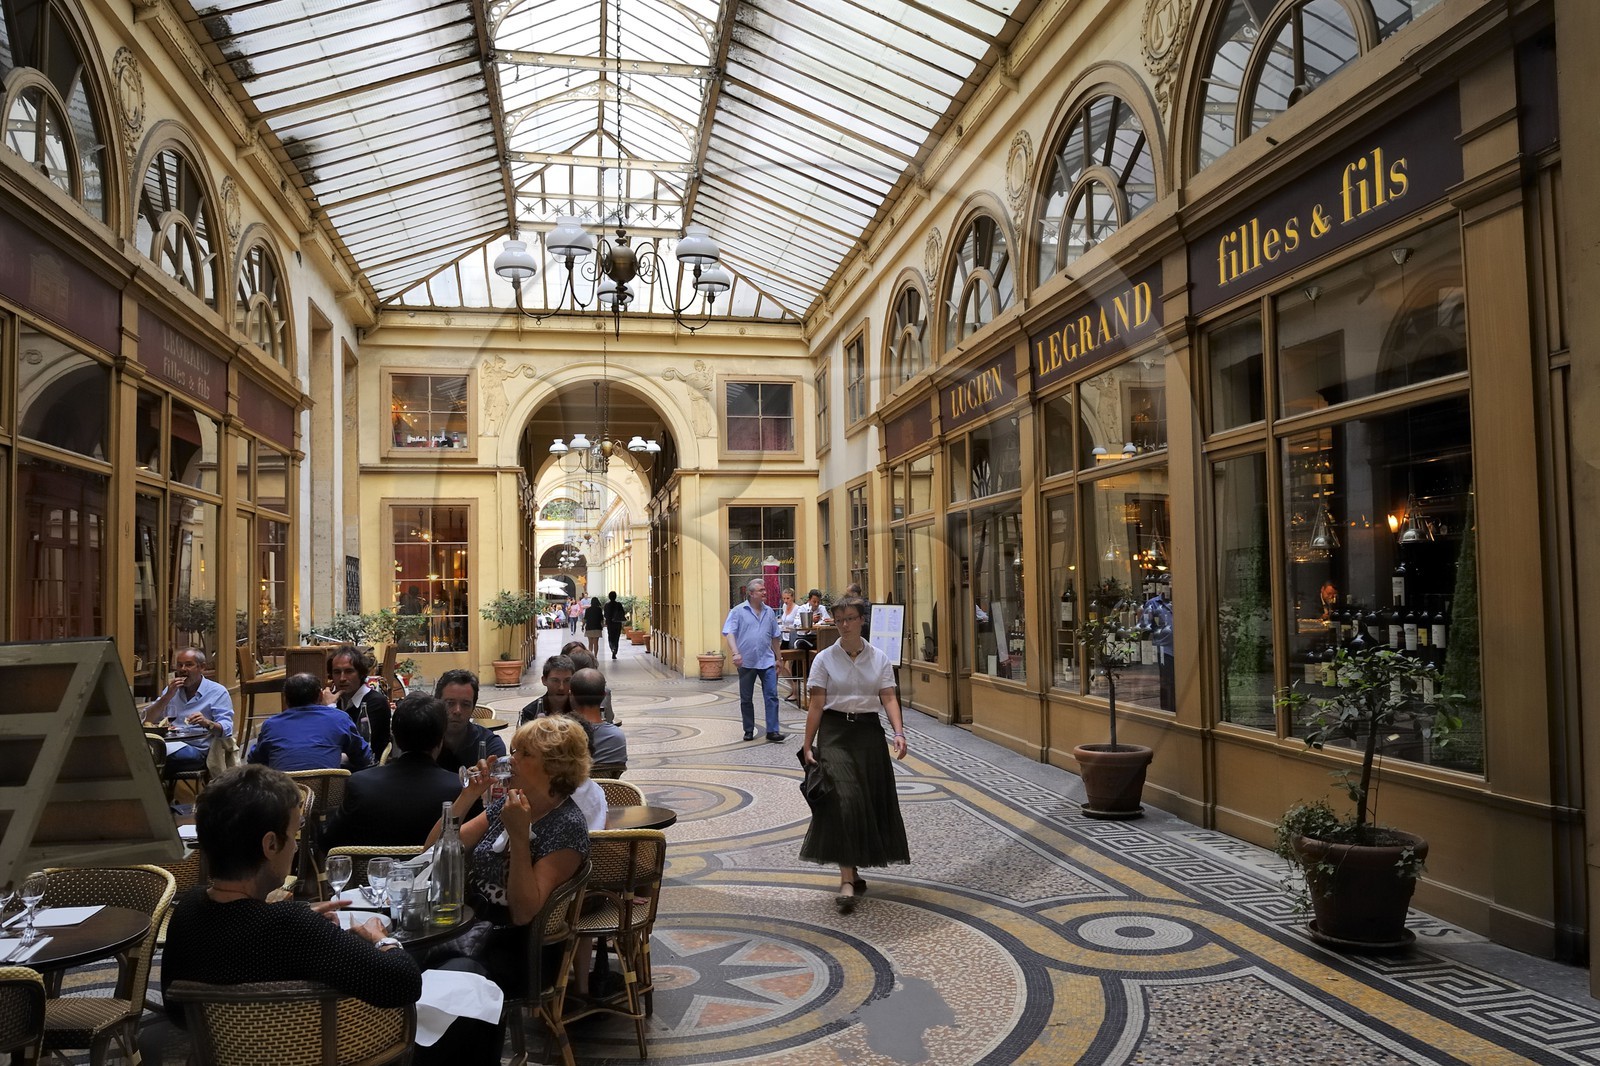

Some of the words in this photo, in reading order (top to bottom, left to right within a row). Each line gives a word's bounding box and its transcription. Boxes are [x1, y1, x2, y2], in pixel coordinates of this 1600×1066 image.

[1217, 217, 1301, 287] filles
[1310, 203, 1333, 239] &
[1339, 147, 1409, 226] fils
[162, 325, 210, 375] LEGRAND
[1036, 281, 1152, 377] LEGRAND
[163, 356, 186, 386] filles
[197, 377, 210, 400] fils
[950, 364, 1004, 419] LUCIEN
